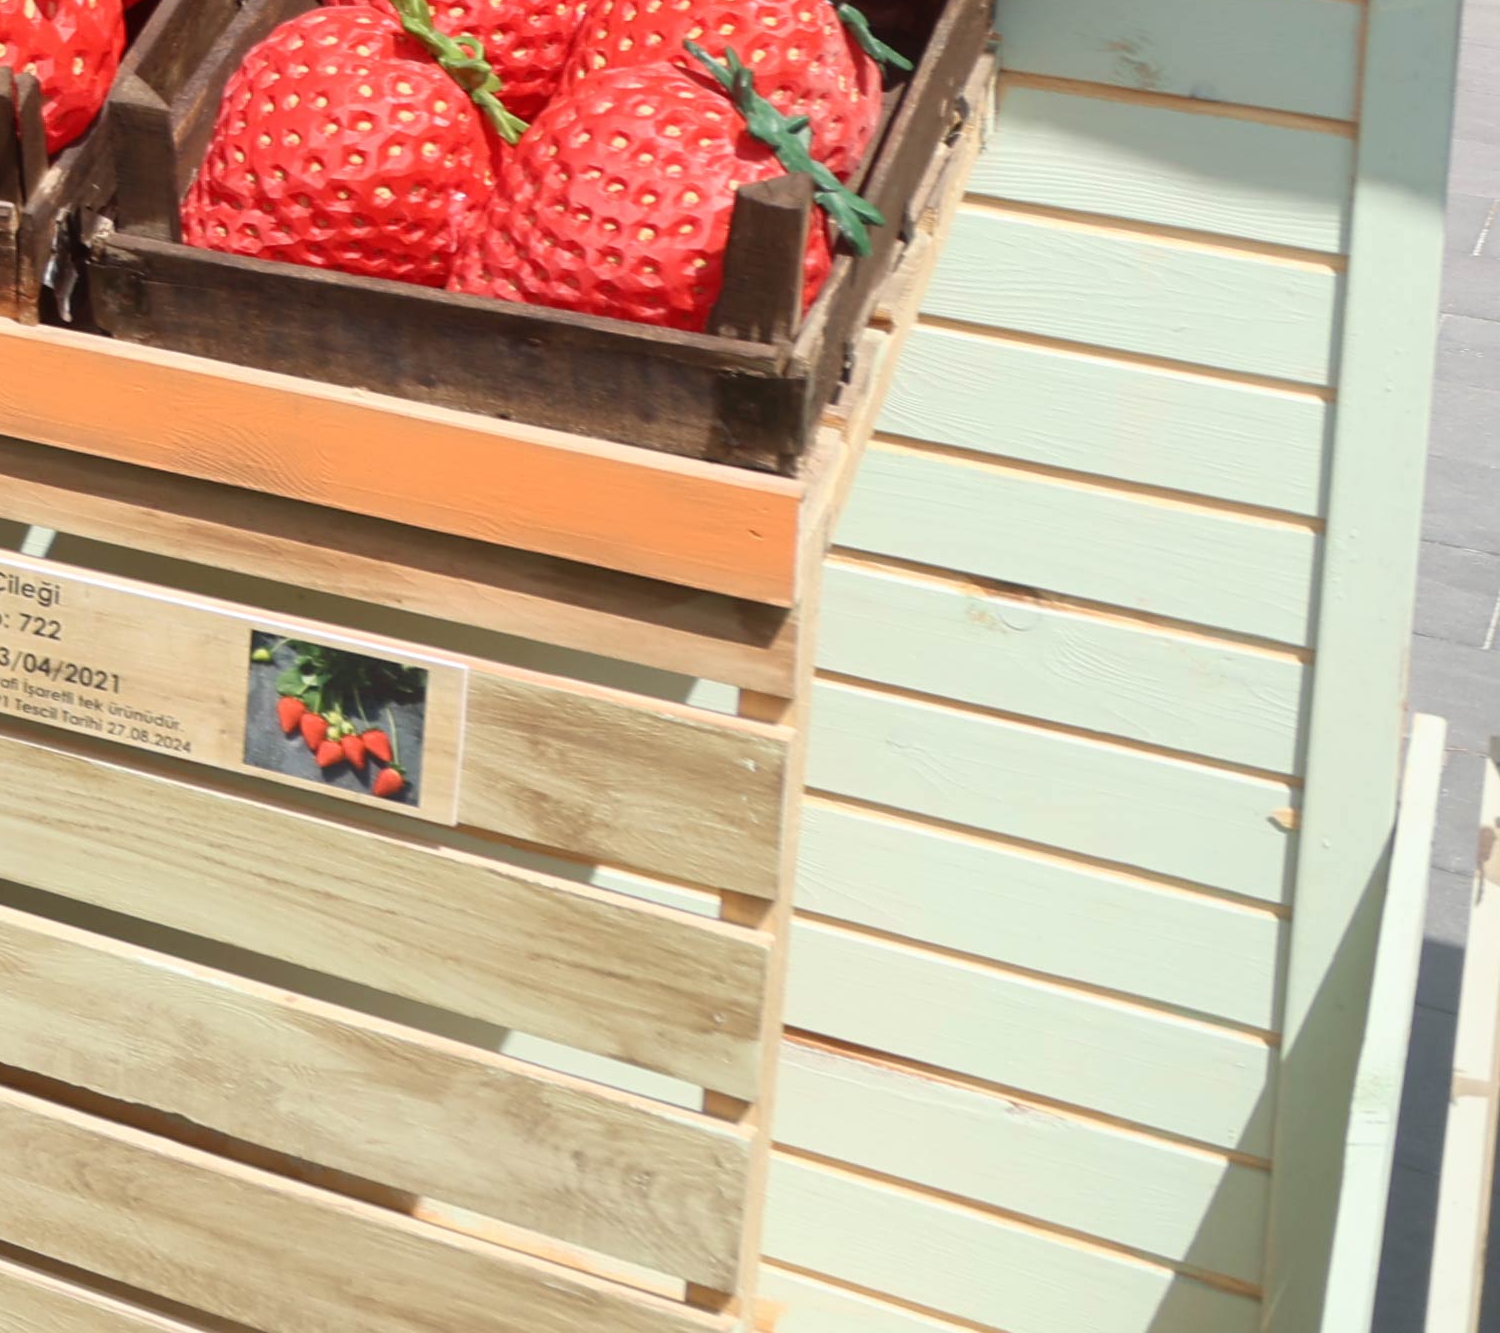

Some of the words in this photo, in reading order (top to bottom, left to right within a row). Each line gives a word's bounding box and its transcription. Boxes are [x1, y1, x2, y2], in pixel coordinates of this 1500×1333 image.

[18, 612, 62, 641] 722
[14, 697, 58, 720] Tescil
[62, 709, 104, 732] Tarihi
[77, 694, 105, 713] tek
